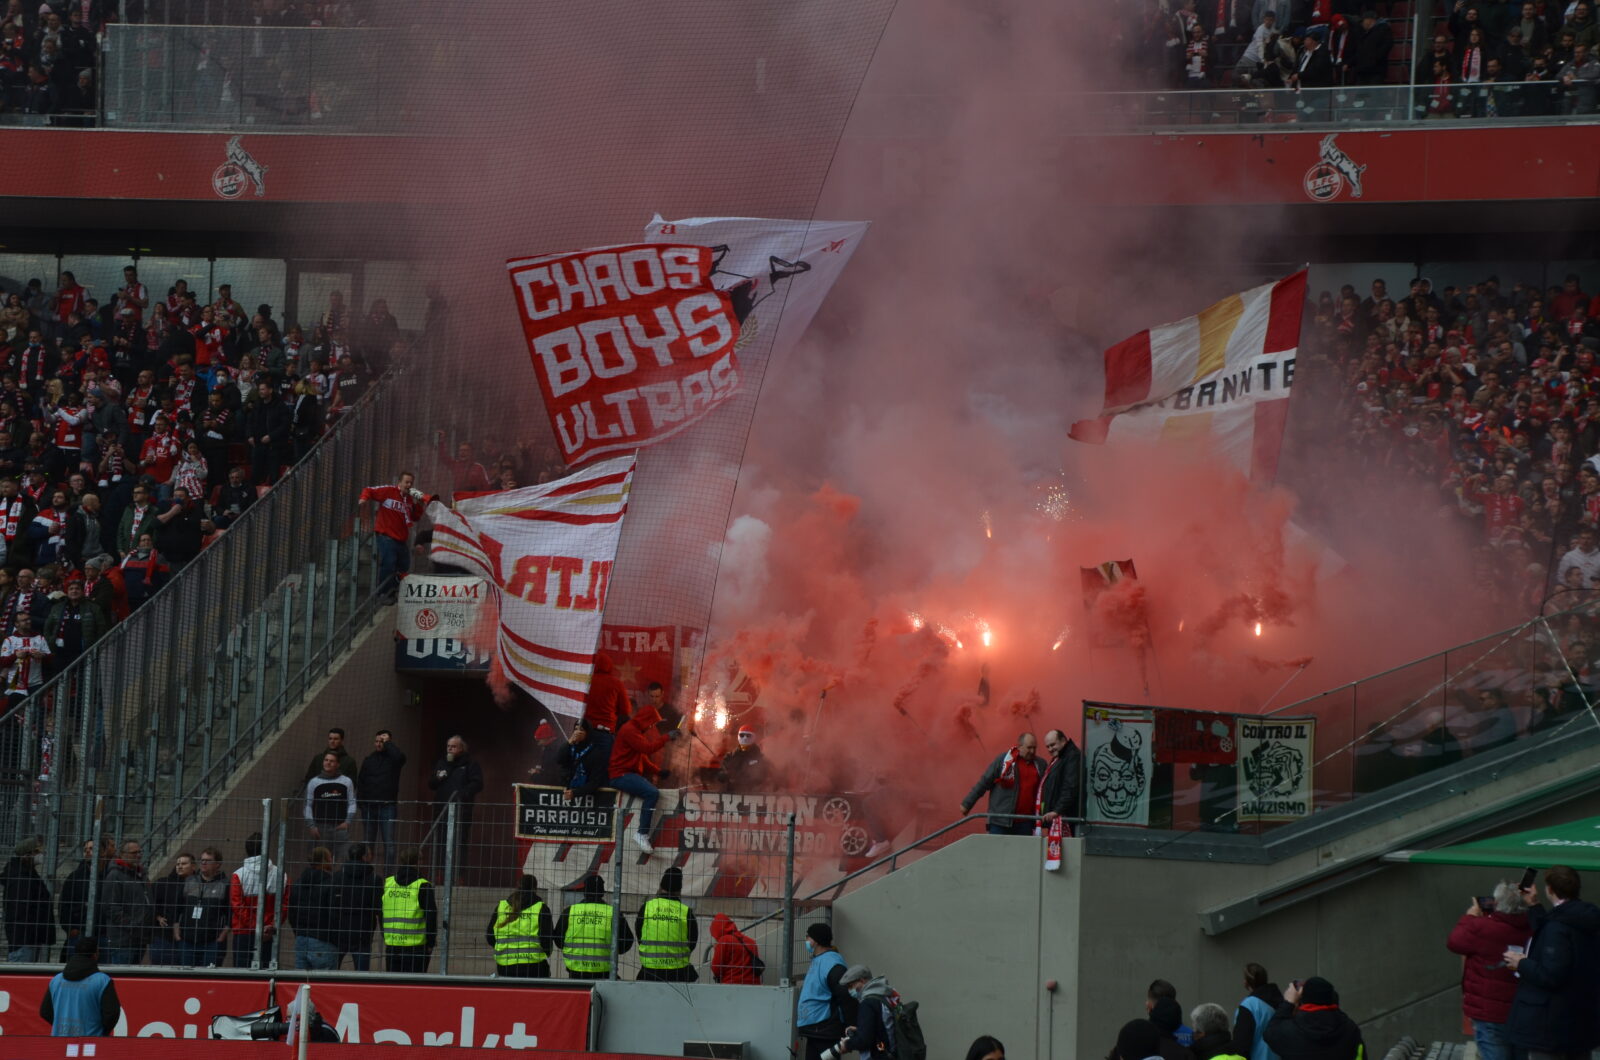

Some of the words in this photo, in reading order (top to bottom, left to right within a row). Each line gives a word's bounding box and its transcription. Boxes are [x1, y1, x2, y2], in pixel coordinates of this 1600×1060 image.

[513, 247, 701, 321] CHAOS
[532, 291, 733, 398] BOYS
[1157, 359, 1296, 410] BANNTE
[556, 353, 738, 454] ULTRAS
[405, 583, 480, 599] MBMM
[600, 630, 671, 652] LTRA
[1242, 725, 1291, 739] CONTRO
[1294, 726, 1307, 739] IL
[525, 809, 607, 826] PARADISO
[683, 793, 818, 826] SEKTION
[1242, 802, 1305, 815] RAZZISMO
[684, 827, 834, 853] STADIONVERBO
[577, 917, 602, 925] ORDNER
[653, 914, 679, 923] ORDNER
